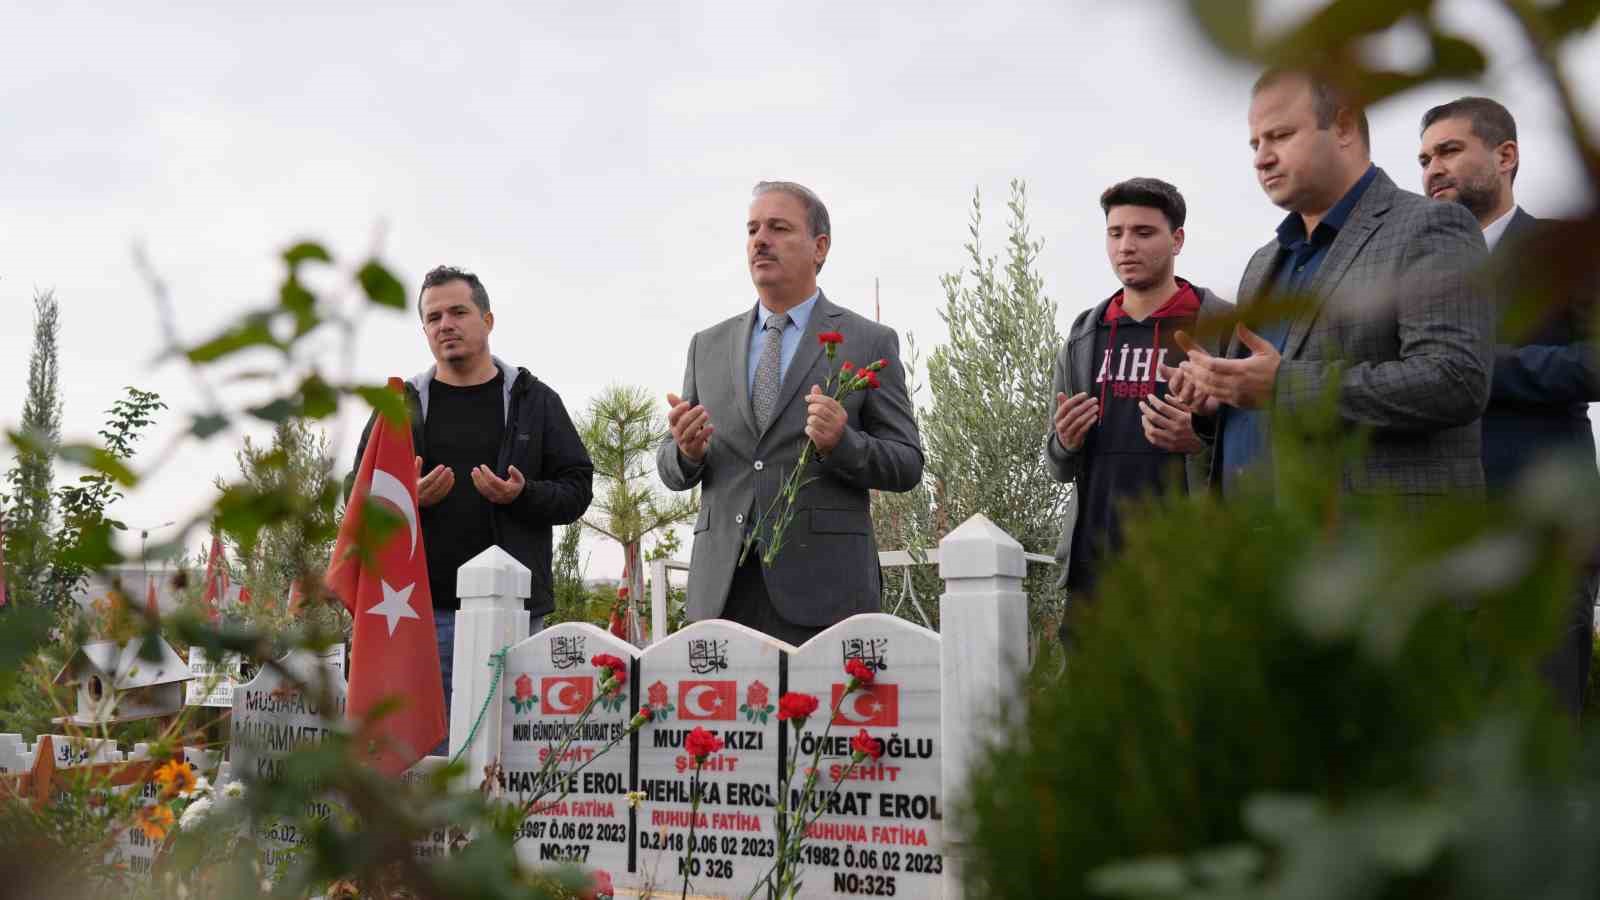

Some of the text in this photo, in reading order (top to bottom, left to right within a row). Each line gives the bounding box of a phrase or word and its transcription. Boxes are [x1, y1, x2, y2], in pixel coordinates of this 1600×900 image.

[725, 730, 763, 750] KIZI
[800, 731, 866, 758] ÖME
[583, 771, 627, 795] EROL
[829, 761, 901, 783] ŞEHİT
[726, 782, 776, 807] EROL
[879, 792, 943, 821] EROL
[571, 799, 615, 818] FATİHA
[651, 809, 762, 832] RUHUNA FATİHA
[549, 818, 576, 840] Ö.06
[578, 822, 594, 841] 02
[596, 823, 627, 843] 2023
[871, 823, 929, 847] FATİHA
[540, 843, 590, 863] NO:327
[721, 836, 738, 856] 02
[740, 838, 775, 858] 2023
[705, 859, 734, 880] 326
[843, 845, 878, 869] Ö.06
[881, 850, 901, 872] 02
[904, 852, 944, 875] 2023
[833, 871, 896, 897] NO:325
